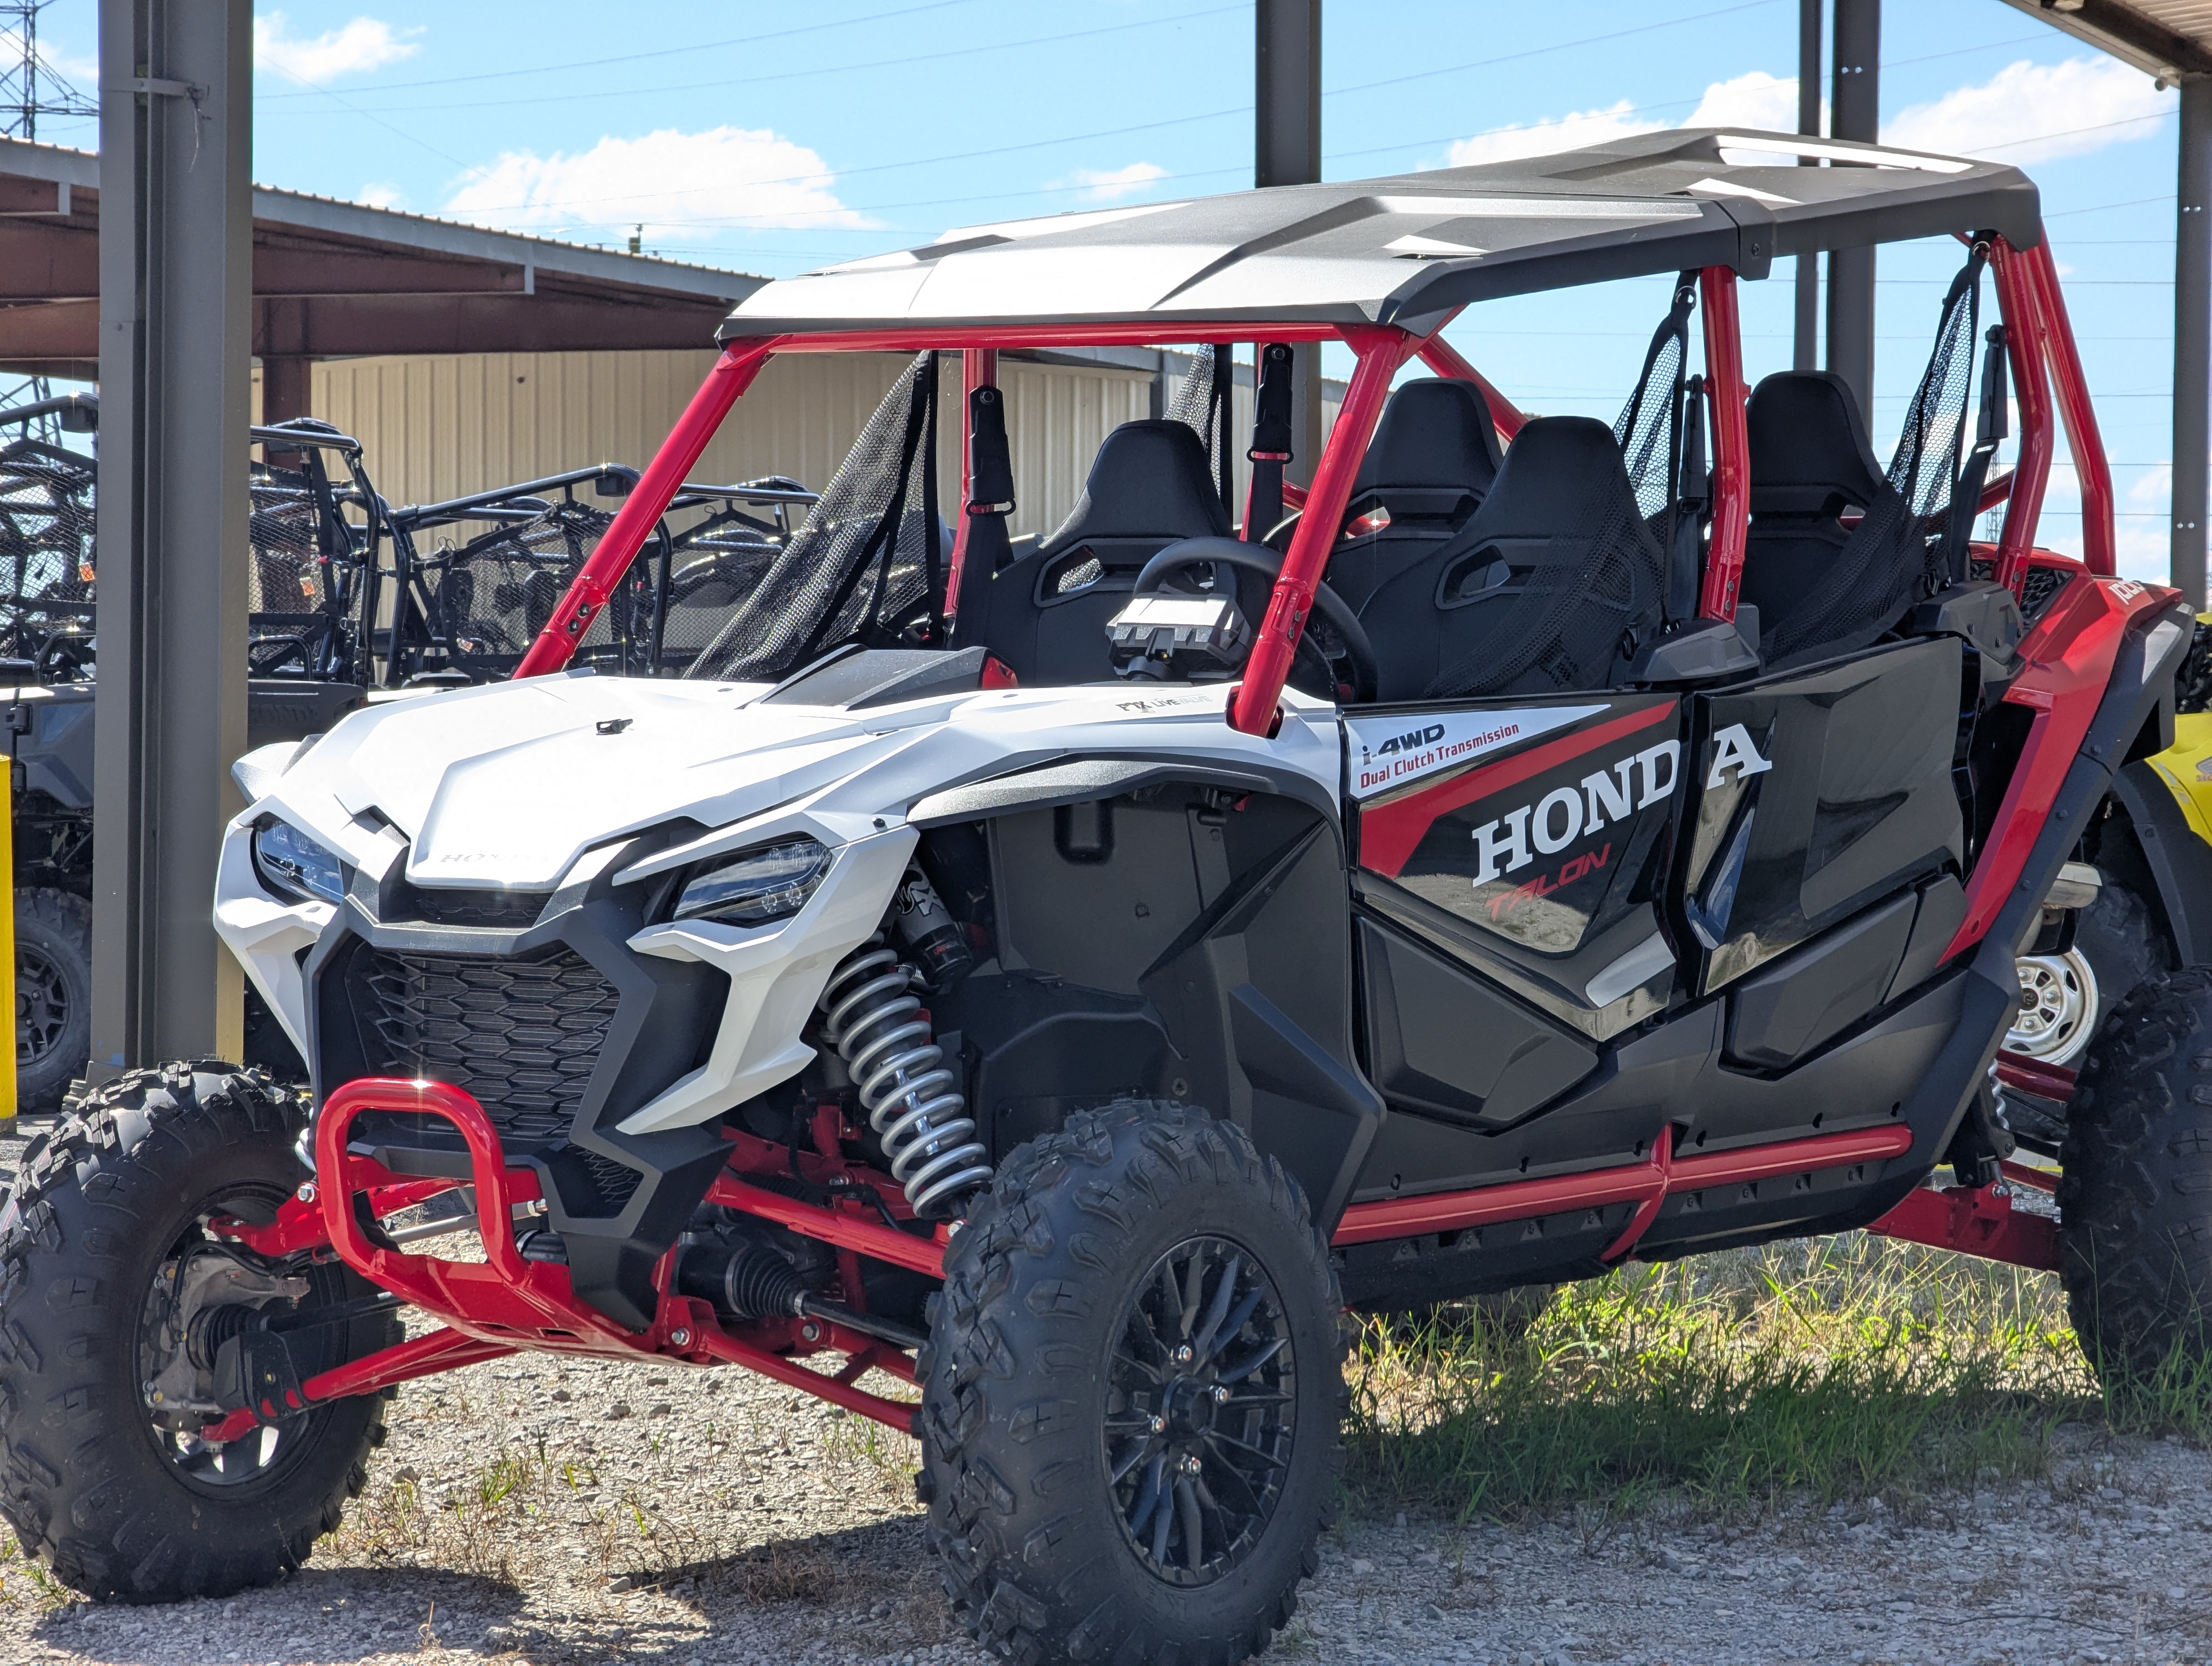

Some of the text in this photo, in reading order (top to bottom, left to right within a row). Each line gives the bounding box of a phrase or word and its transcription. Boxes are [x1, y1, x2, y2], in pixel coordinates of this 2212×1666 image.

[1360, 723, 1520, 789] Dual Clutch Transmission
[1362, 723, 1445, 766] i-4WD
[1484, 842, 1611, 922] TALON
